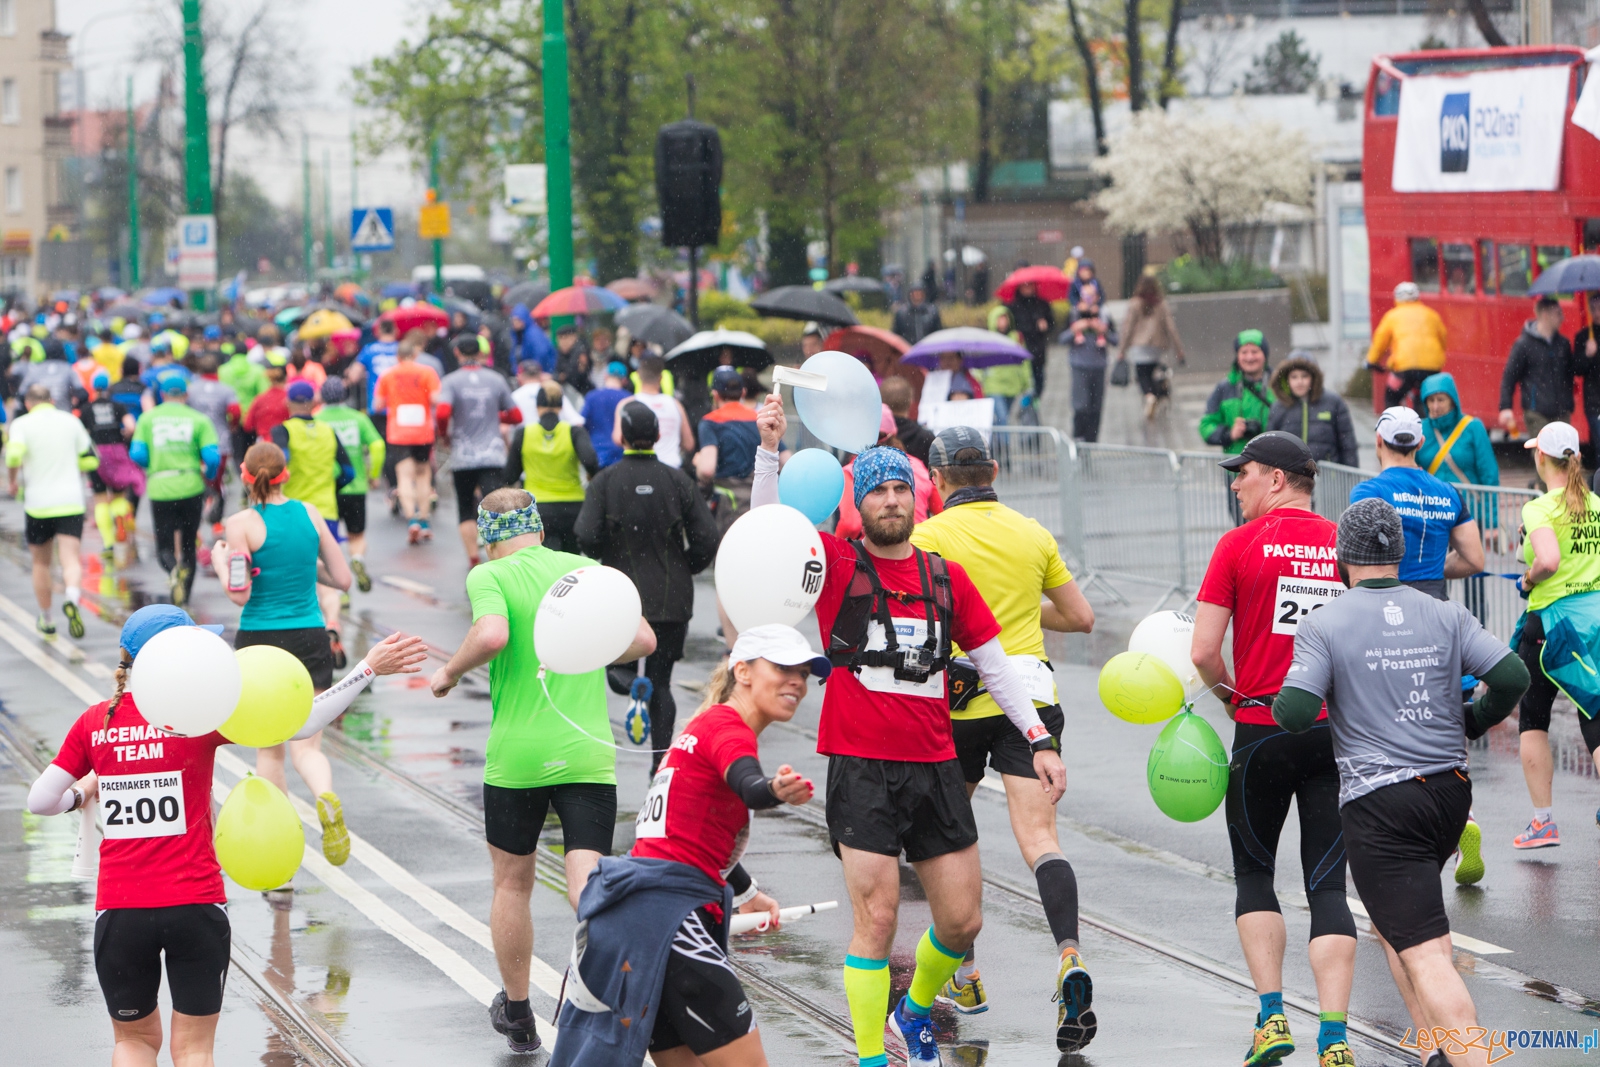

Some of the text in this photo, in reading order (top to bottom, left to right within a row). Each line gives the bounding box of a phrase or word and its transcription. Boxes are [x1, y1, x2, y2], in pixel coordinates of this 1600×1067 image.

[1442, 113, 1468, 151] PKO
[1423, 510, 1456, 521] SUWART
[1570, 525, 1600, 540] ZWOL
[1569, 541, 1600, 555] AUTY
[1290, 560, 1334, 578] TEAM
[1280, 583, 1329, 597] PACEMAKER
[1278, 600, 1325, 625] 2:
[1173, 626, 1192, 634] Bank
[1382, 628, 1414, 637] Bank Polski
[1365, 644, 1438, 658] Mój ślad pozostał
[1367, 654, 1439, 671] w Poznaniu
[1411, 671, 1426, 687] 17
[1405, 689, 1431, 705] .04
[1394, 706, 1433, 723] .2016
[113, 742, 164, 762] TEAM
[101, 776, 178, 792] PACEMAKER TEAM
[104, 795, 180, 826] 2:00
